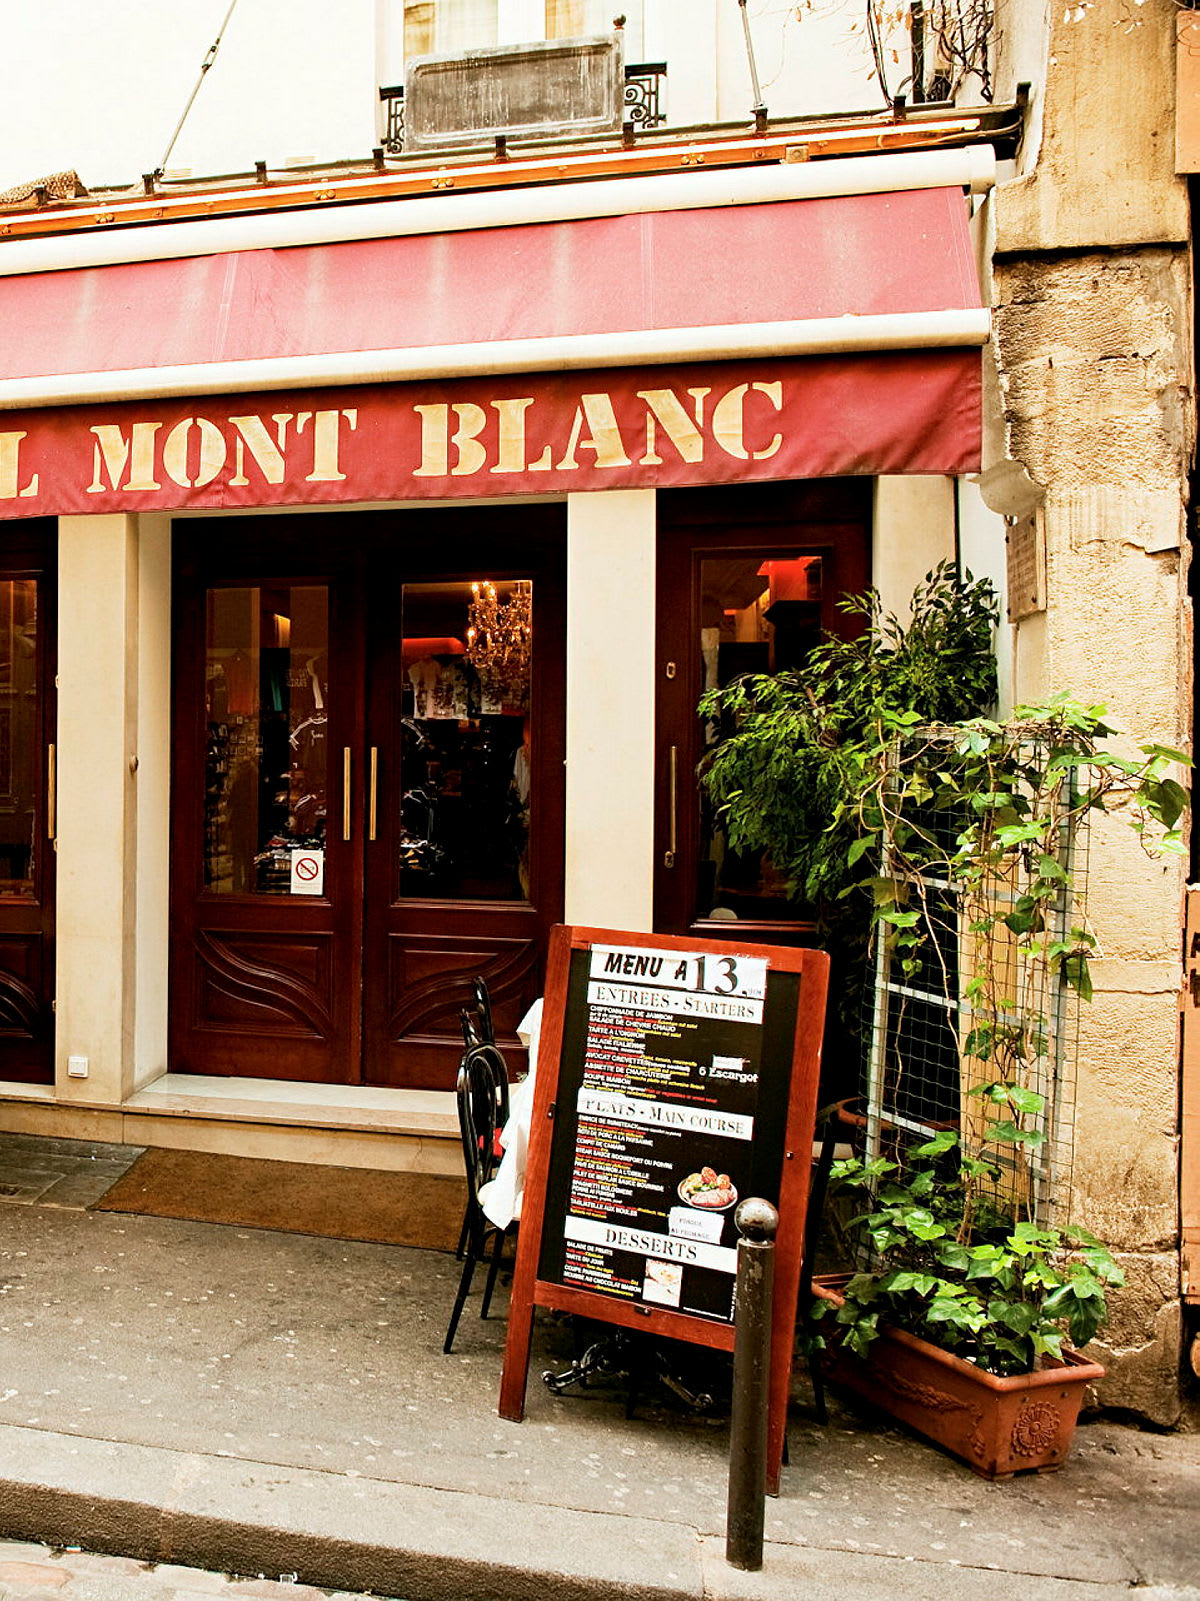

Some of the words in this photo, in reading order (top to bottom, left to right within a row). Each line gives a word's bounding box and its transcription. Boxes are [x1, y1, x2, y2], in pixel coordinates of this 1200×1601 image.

[86, 409, 359, 494] MONT
[413, 380, 783, 476] BLANC
[604, 952, 663, 978] MENU
[674, 960, 688, 981] A
[596, 986, 670, 1009] ENTREES
[683, 995, 755, 1020] STARTERS
[709, 1067, 759, 1083] Escargot
[586, 1099, 637, 1117] PLATS
[649, 1106, 686, 1125] MAIN
[689, 1114, 745, 1135] COURSE
[605, 1228, 698, 1260] DESSERTS
